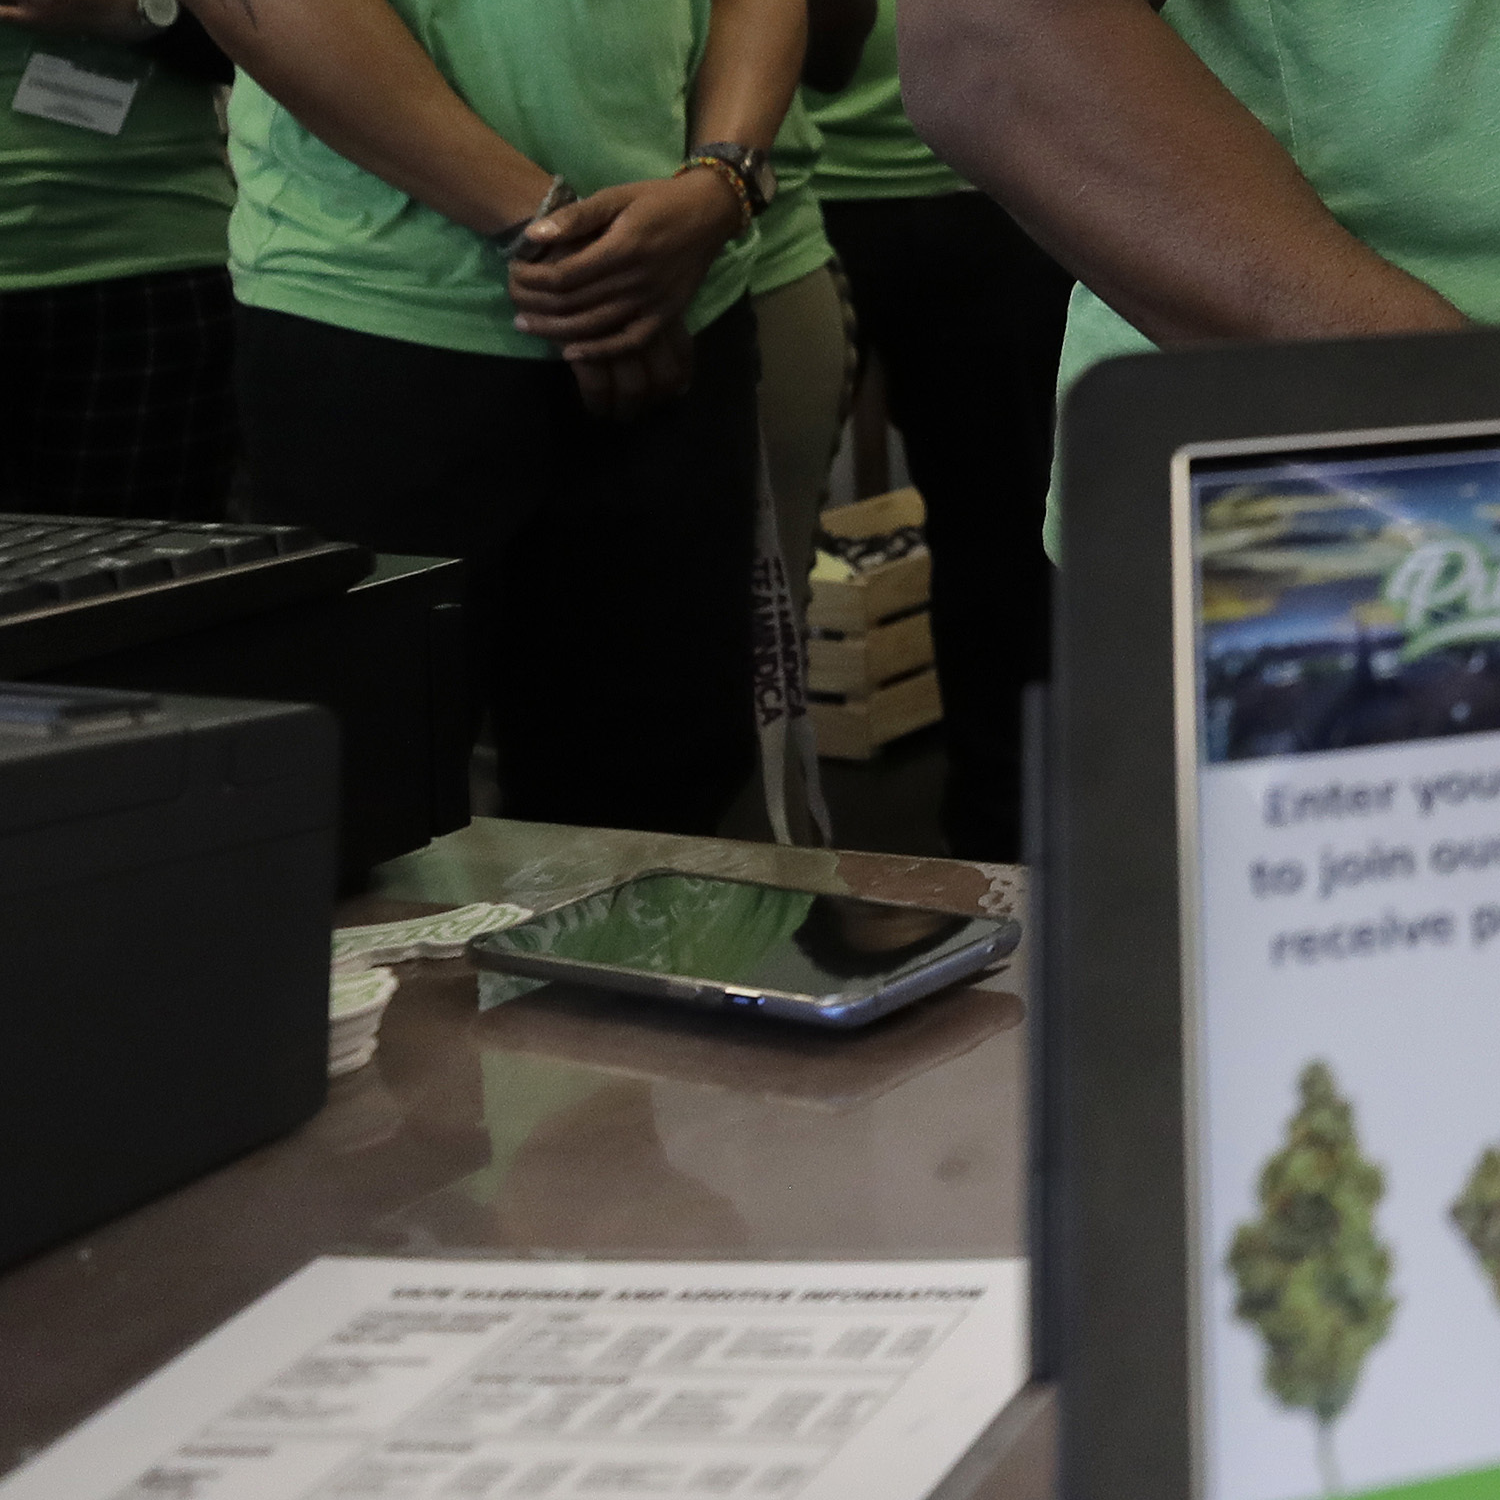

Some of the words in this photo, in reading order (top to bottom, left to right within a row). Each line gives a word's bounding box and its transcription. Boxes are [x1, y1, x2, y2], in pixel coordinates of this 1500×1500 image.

[1263, 782, 1396, 827] Enter
[1250, 858, 1305, 899] to
[1318, 842, 1416, 901] join
[1269, 907, 1454, 966] receive
